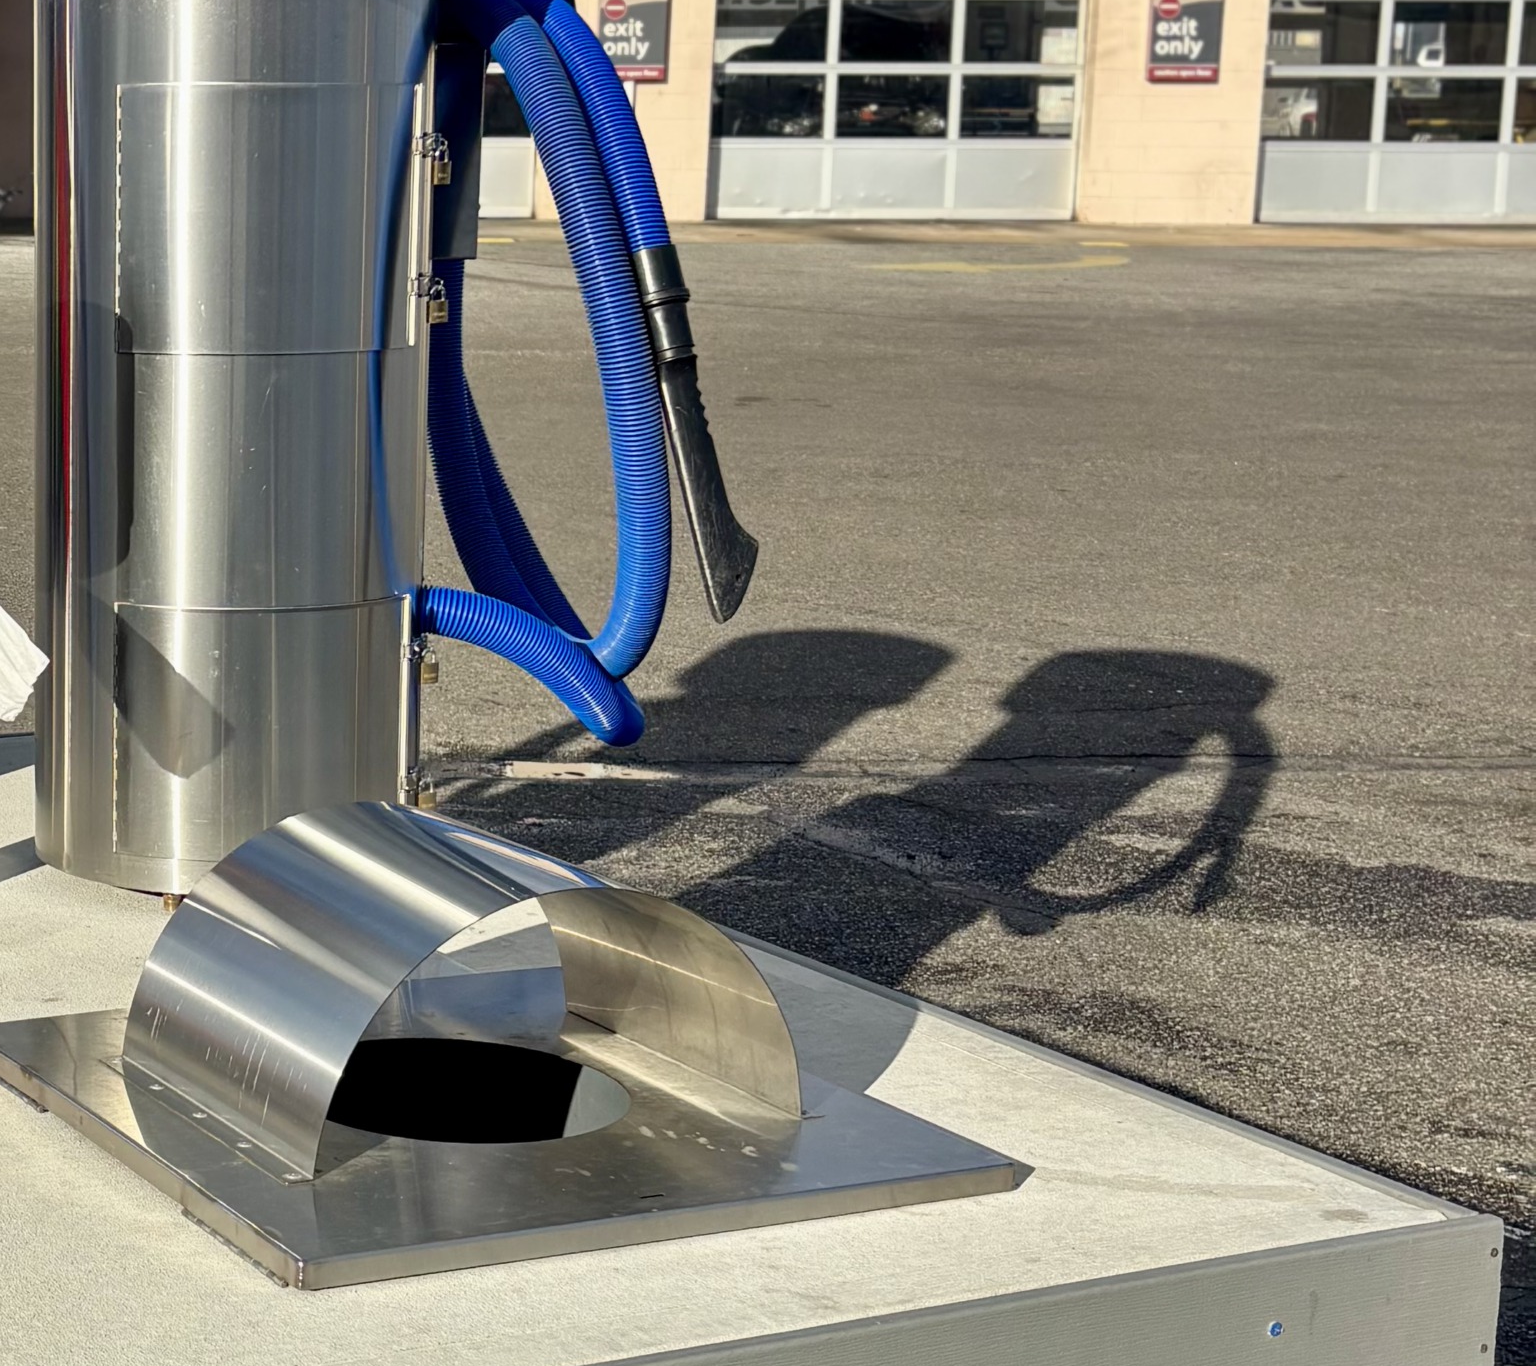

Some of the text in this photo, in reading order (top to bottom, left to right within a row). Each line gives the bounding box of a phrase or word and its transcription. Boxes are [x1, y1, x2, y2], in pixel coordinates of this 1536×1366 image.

[603, 18, 644, 37] exit
[1155, 17, 1199, 37] exit
[602, 36, 650, 61] only
[1154, 36, 1205, 61] only
